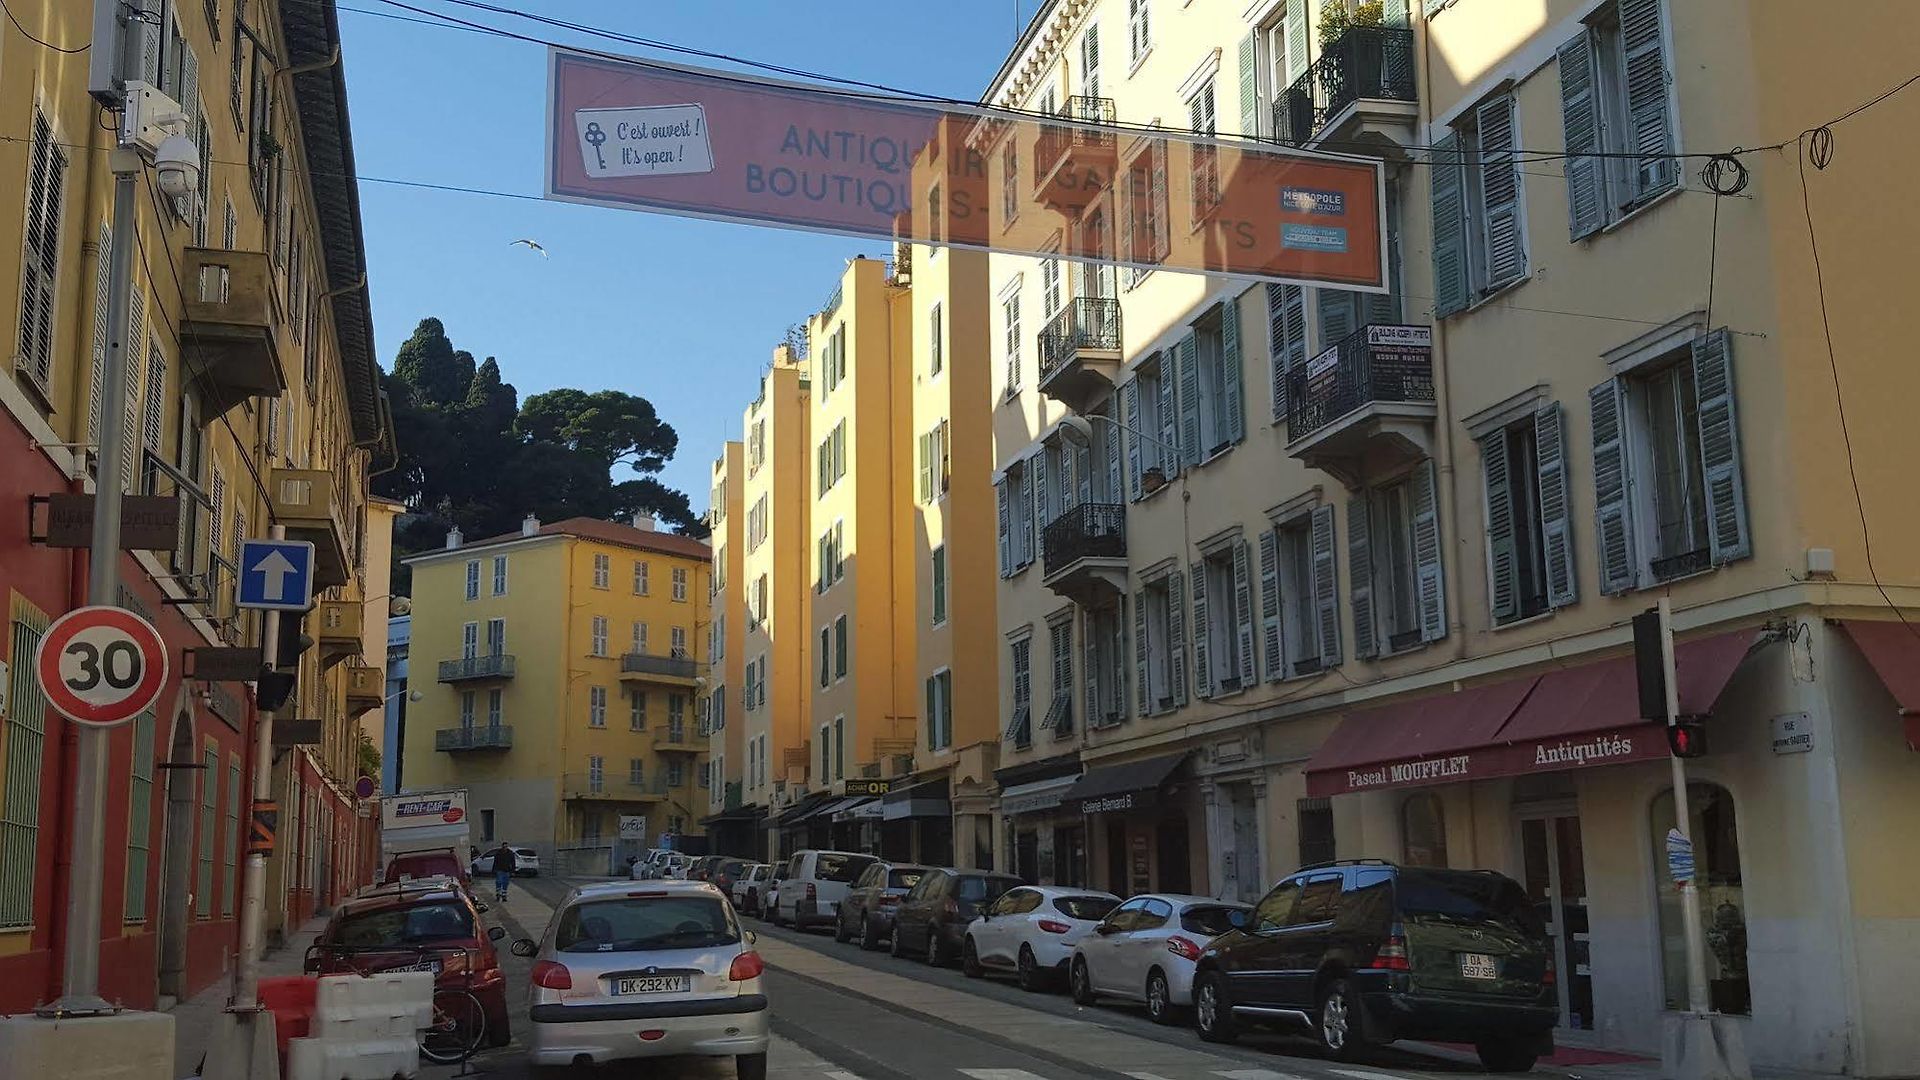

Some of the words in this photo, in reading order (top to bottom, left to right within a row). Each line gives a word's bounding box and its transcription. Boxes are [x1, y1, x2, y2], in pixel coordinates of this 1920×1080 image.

[617, 122, 648, 140] C'est
[651, 120, 691, 139] ouvert
[622, 147, 641, 165] It's
[644, 150, 675, 170] open
[65, 639, 142, 692] 30
[1535, 735, 1632, 765] Antiquités
[1347, 771, 1388, 787] Pascal
[1391, 755, 1470, 783] MOUFFLET
[868, 782, 889, 793] OR
